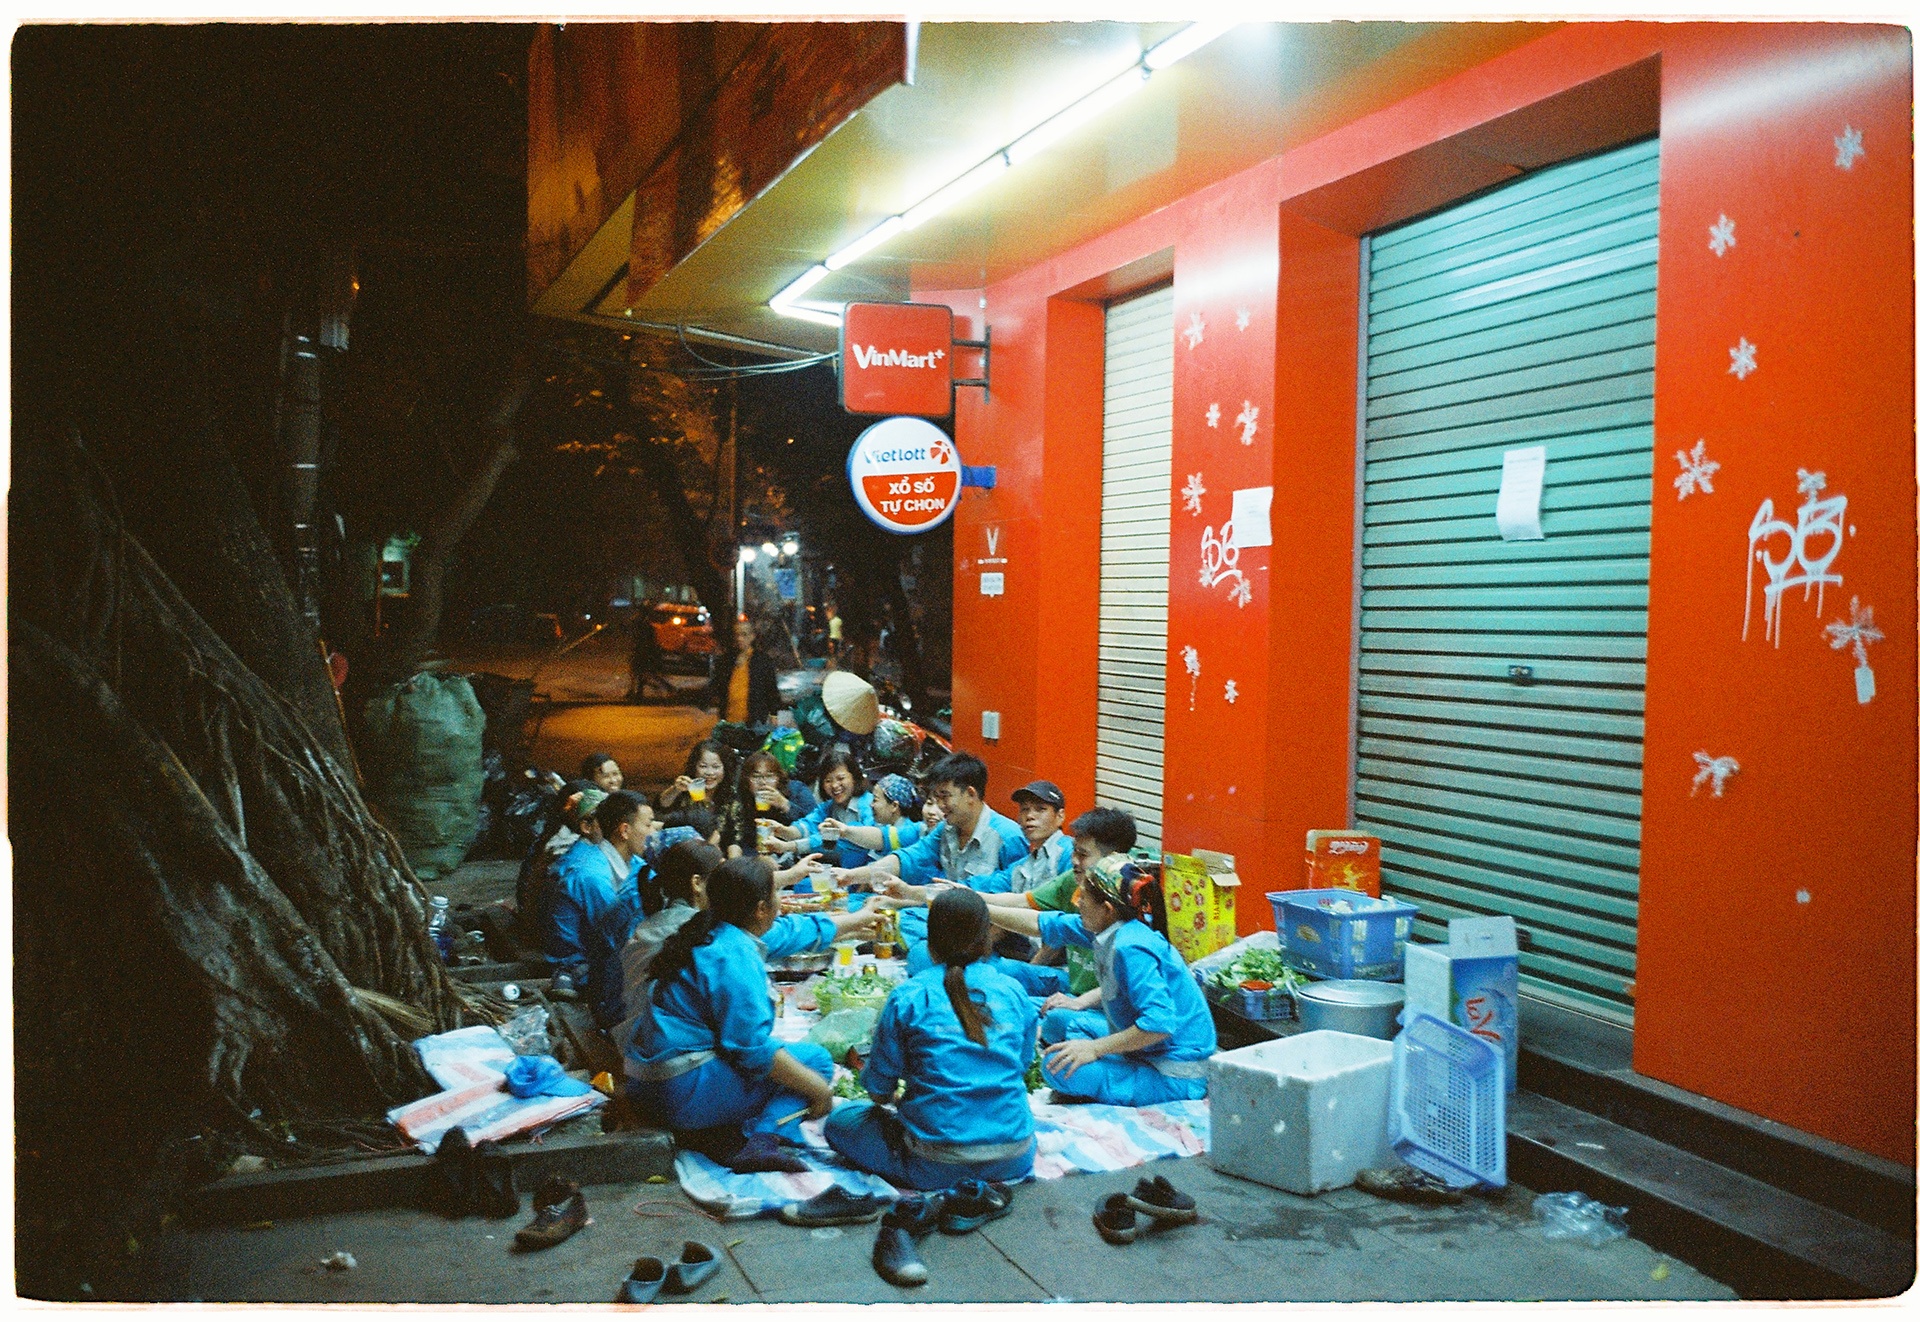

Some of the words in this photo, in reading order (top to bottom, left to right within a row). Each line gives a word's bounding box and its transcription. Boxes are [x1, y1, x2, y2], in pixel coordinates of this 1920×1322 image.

[888, 476, 911, 495] XỔ
[913, 476, 935, 493] SỐ
[880, 499, 902, 515] TỰ
[904, 498, 945, 513] CHỌN
